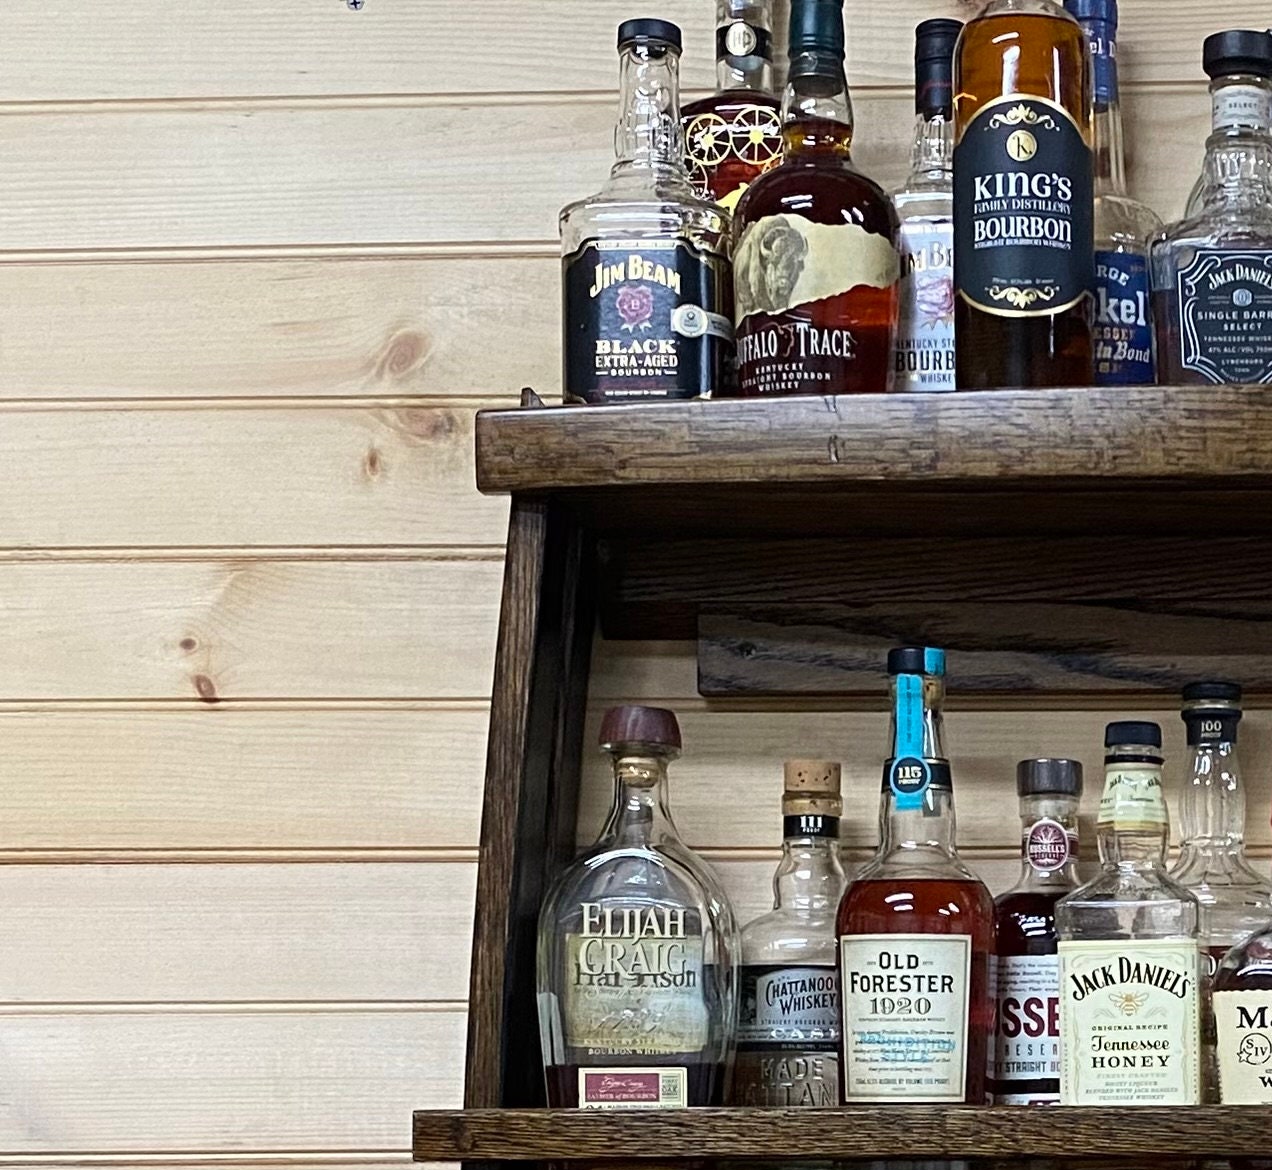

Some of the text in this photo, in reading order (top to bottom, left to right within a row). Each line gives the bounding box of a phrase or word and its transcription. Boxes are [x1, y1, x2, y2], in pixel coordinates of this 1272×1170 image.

[974, 216, 1072, 242] BOURBON
[628, 254, 681, 296] BEAM
[1208, 267, 1235, 290] JACK
[1197, 310, 1239, 321] SINGLE
[1223, 322, 1262, 331] SELECT
[596, 339, 677, 354] BLACK
[796, 322, 852, 358] TRACE
[595, 355, 679, 368] EXTRA-AGED
[895, 351, 956, 371] BOURB
[1201, 720, 1222, 732] 100
[579, 902, 688, 945] ELIJAH
[578, 938, 687, 978] CRAIG
[878, 951, 920, 970] OLD
[850, 971, 954, 994] FORESTER
[1070, 964, 1117, 1001] JACK
[1118, 956, 1191, 999] DANIEL'S
[779, 992, 837, 1016] WHISKEY
[869, 996, 932, 1016] 1920
[1091, 1035, 1170, 1051] Tennessee
[1005, 1061, 1047, 1073] STRAIGHT
[1091, 1055, 1171, 1069] HONEY
